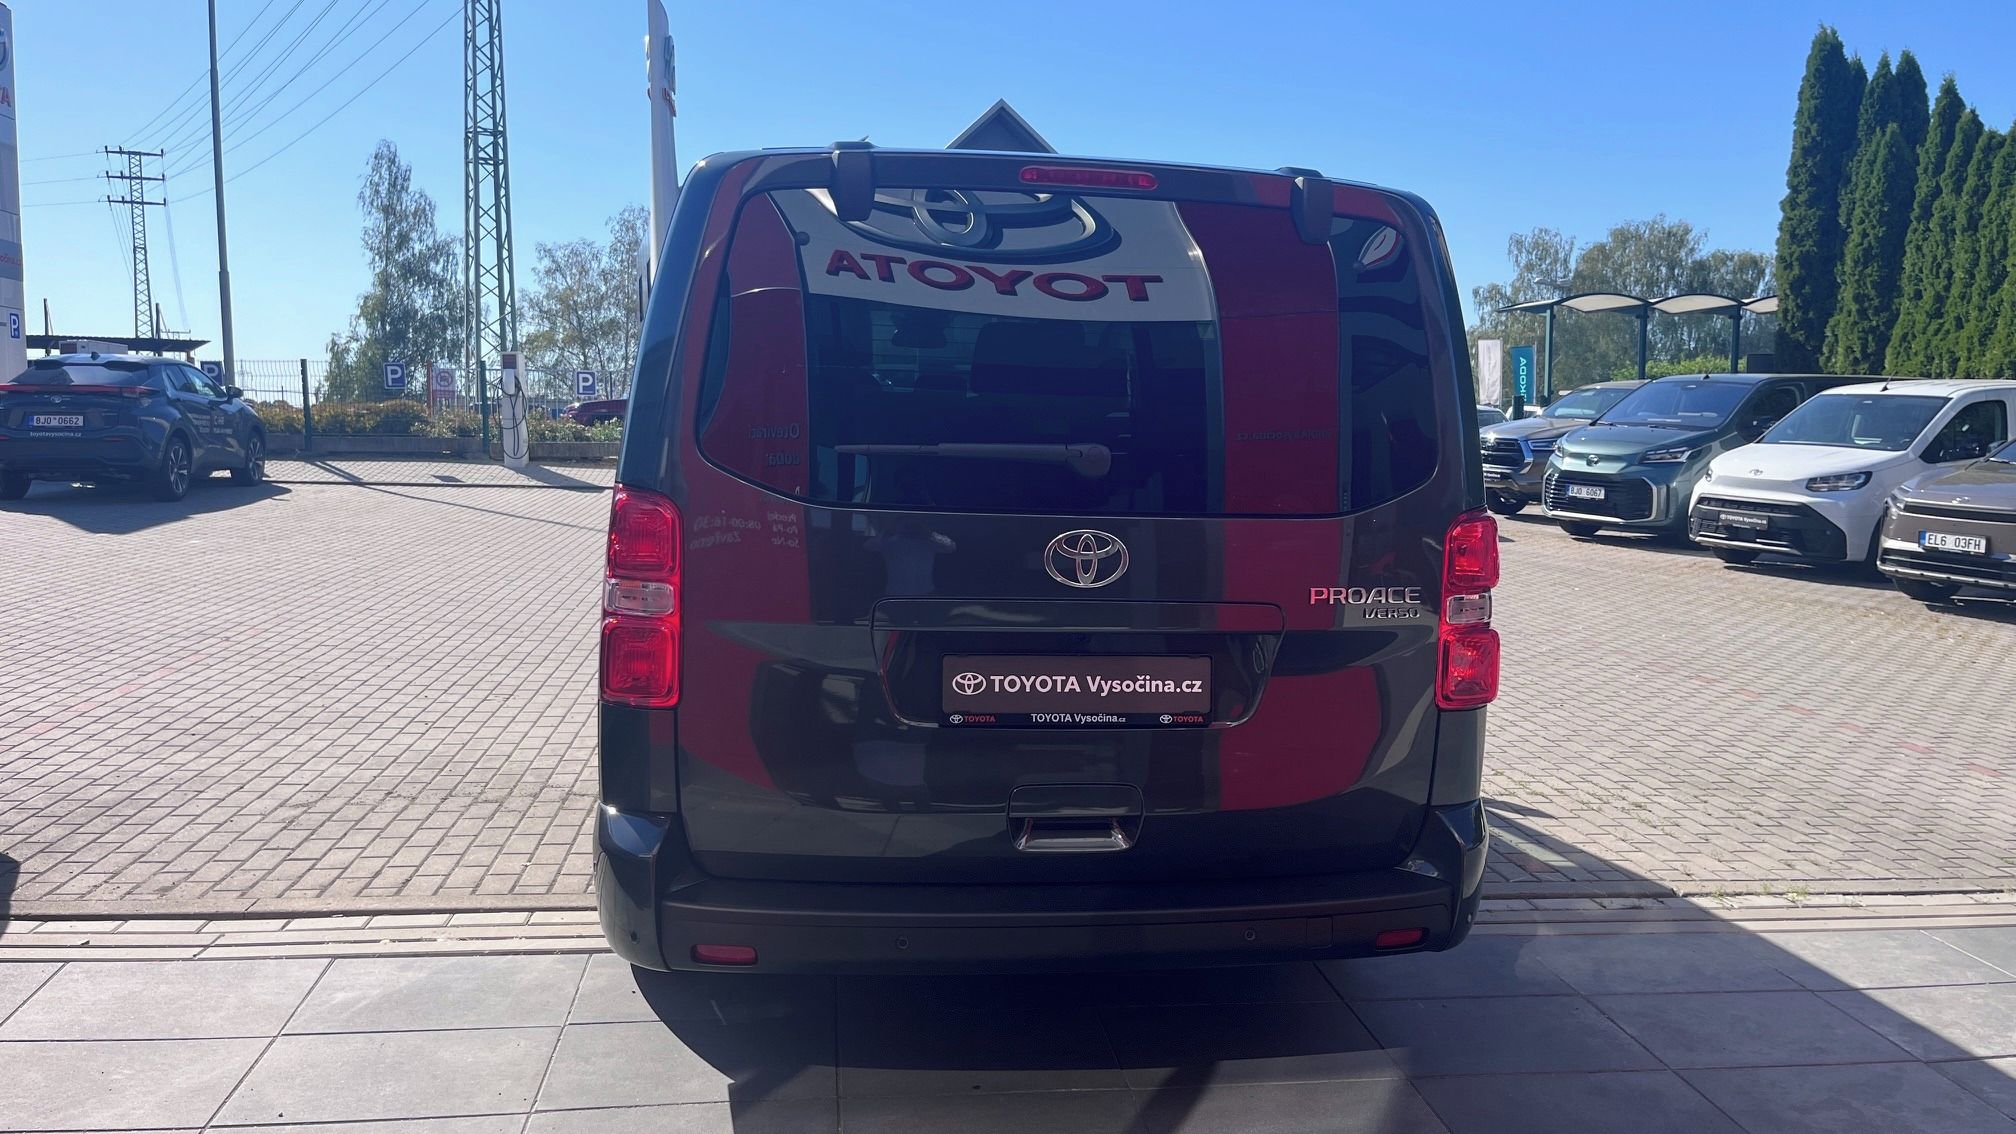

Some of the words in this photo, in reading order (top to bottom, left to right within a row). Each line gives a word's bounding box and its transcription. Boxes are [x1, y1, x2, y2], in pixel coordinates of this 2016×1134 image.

[11, 315, 19, 337] P
[387, 366, 402, 385] P
[579, 374, 594, 394] P
[57, 416, 80, 425] 0662
[1928, 534, 1947, 546] EL6
[1954, 537, 1981, 551] 03FH
[1310, 587, 1421, 605] PROACE
[1363, 607, 1420, 619] VERSO
[990, 675, 1081, 693] TOYOTA
[1086, 675, 1202, 697] Vysočina.cz
[1031, 713, 1072, 723] TOYOTA
[1074, 713, 1126, 725] Vysočina.cz
